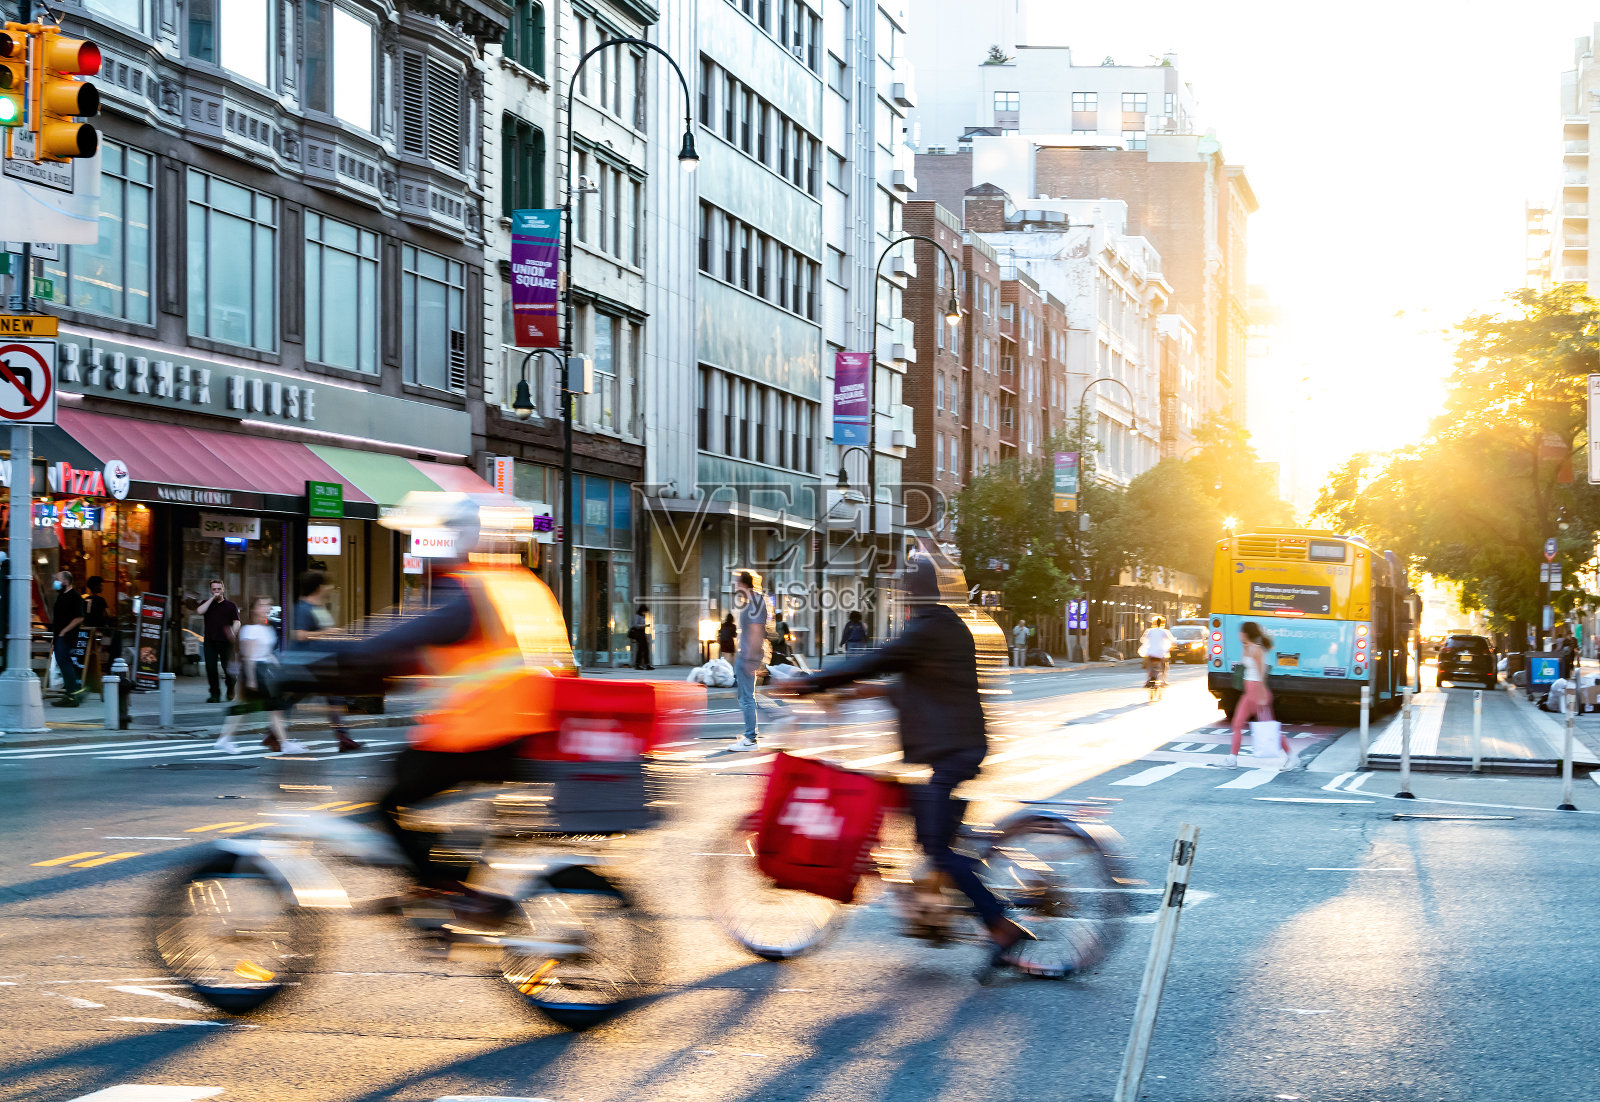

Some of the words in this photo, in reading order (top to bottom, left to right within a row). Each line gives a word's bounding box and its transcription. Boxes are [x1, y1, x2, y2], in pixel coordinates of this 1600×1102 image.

[512, 263, 546, 277] UNION
[515, 274, 557, 290] SQUARE
[0, 319, 34, 332] NEW
[839, 383, 865, 392] UNION
[226, 375, 316, 421] HOUSE
[834, 389, 865, 401] SQUARE
[56, 461, 106, 498] PIZZA
[204, 520, 226, 532] SPA
